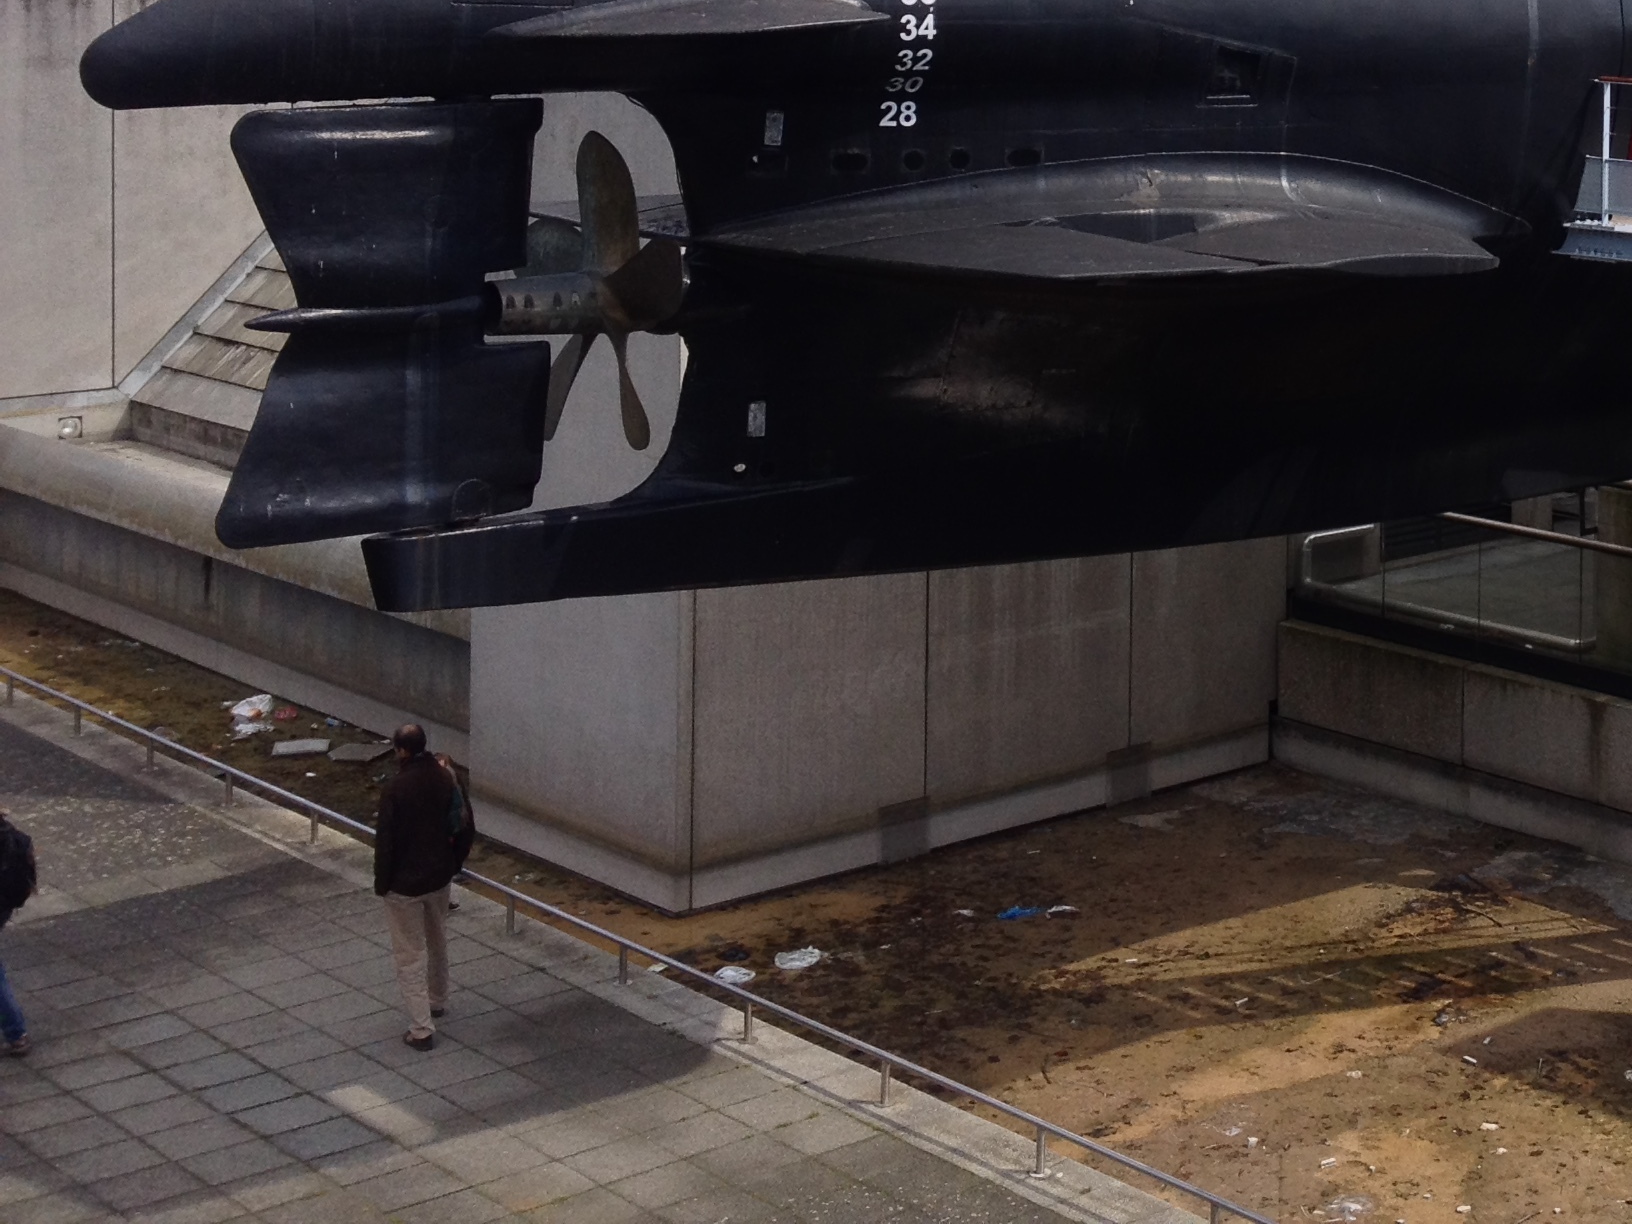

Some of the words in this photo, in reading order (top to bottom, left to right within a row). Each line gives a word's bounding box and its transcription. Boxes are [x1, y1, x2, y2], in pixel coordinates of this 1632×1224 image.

[899, 13, 937, 41] 34
[894, 48, 934, 71] 32
[885, 76, 924, 93] 30
[879, 100, 918, 127] 28
